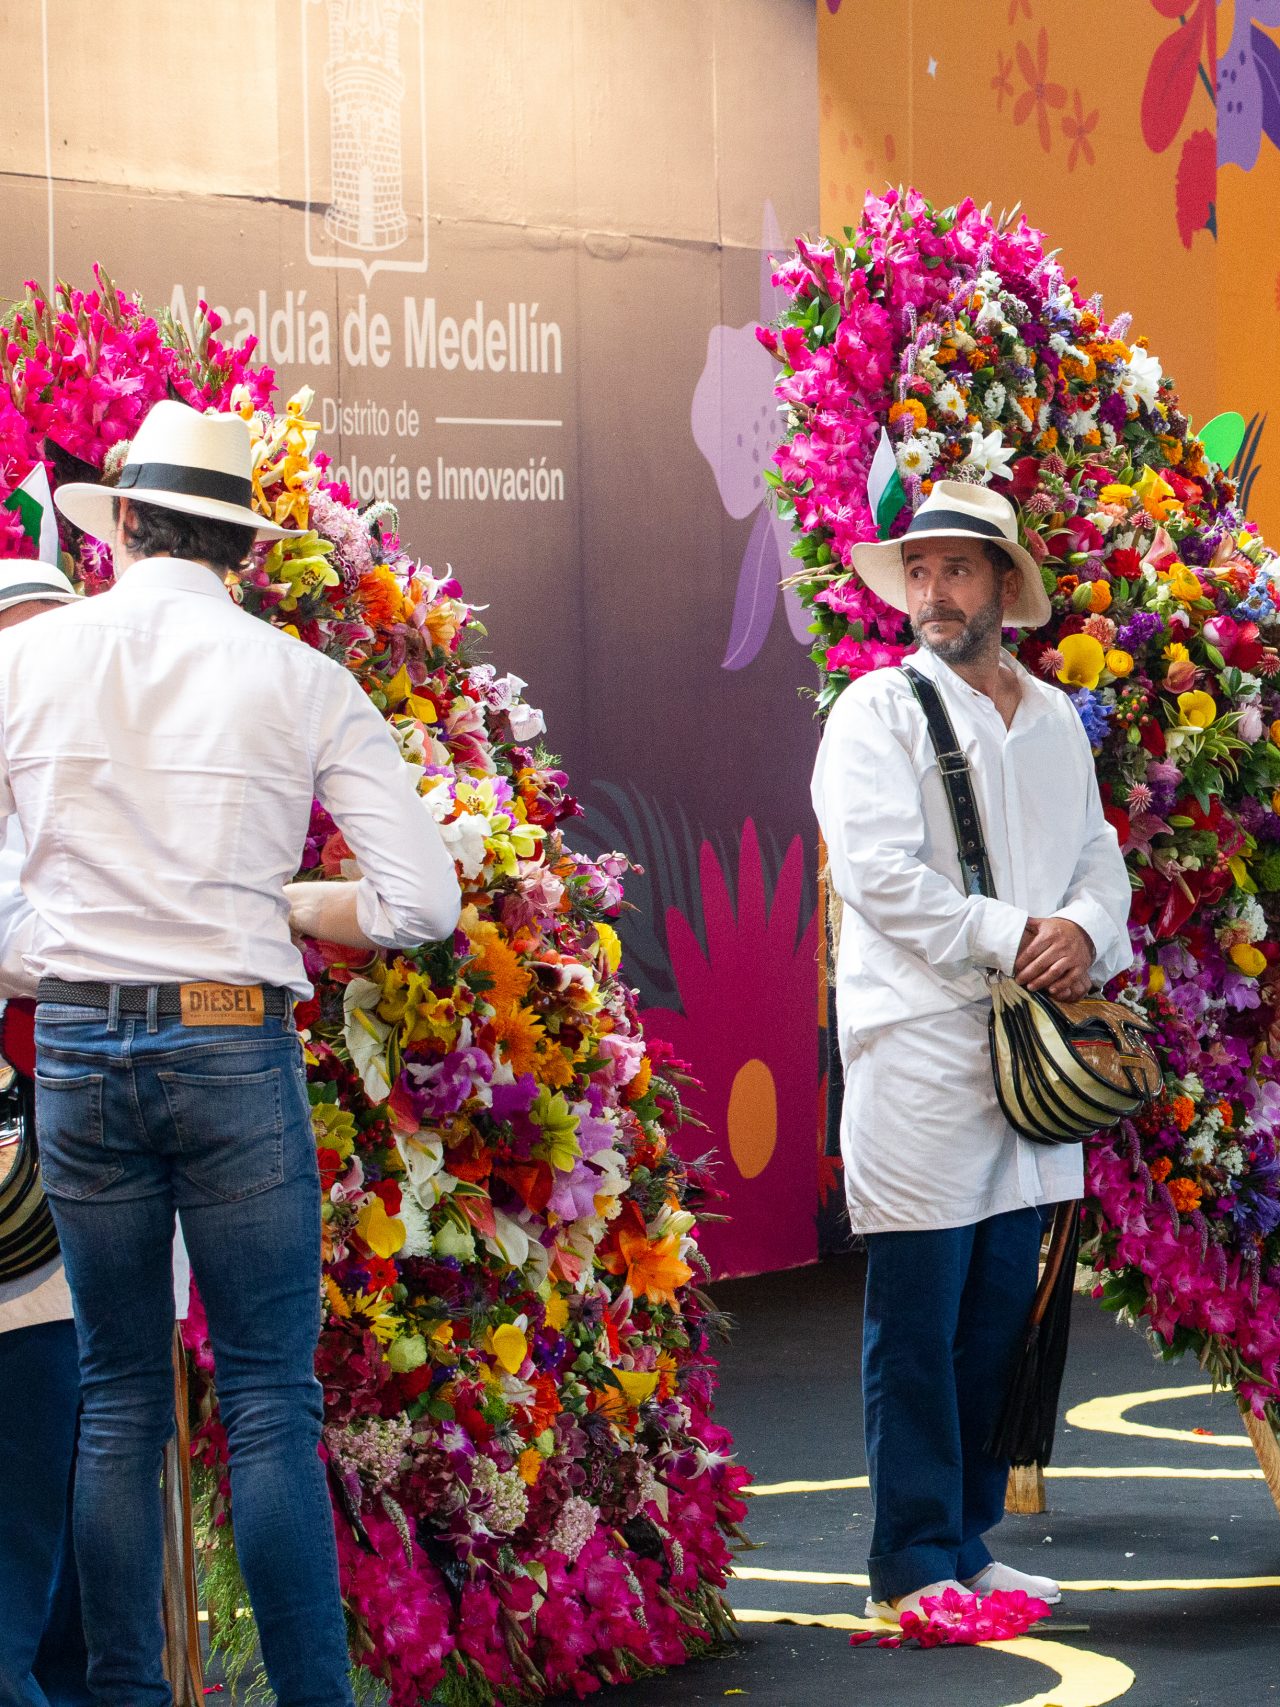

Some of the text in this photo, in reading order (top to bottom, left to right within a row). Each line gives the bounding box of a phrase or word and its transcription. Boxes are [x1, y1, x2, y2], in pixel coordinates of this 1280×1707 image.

[343, 294, 392, 368] de
[404, 296, 562, 374] Medellín
[322, 397, 420, 437] Distrito de
[416, 466, 431, 501] e
[437, 456, 565, 502] Innovación
[189, 989, 256, 1012] DIESEL
